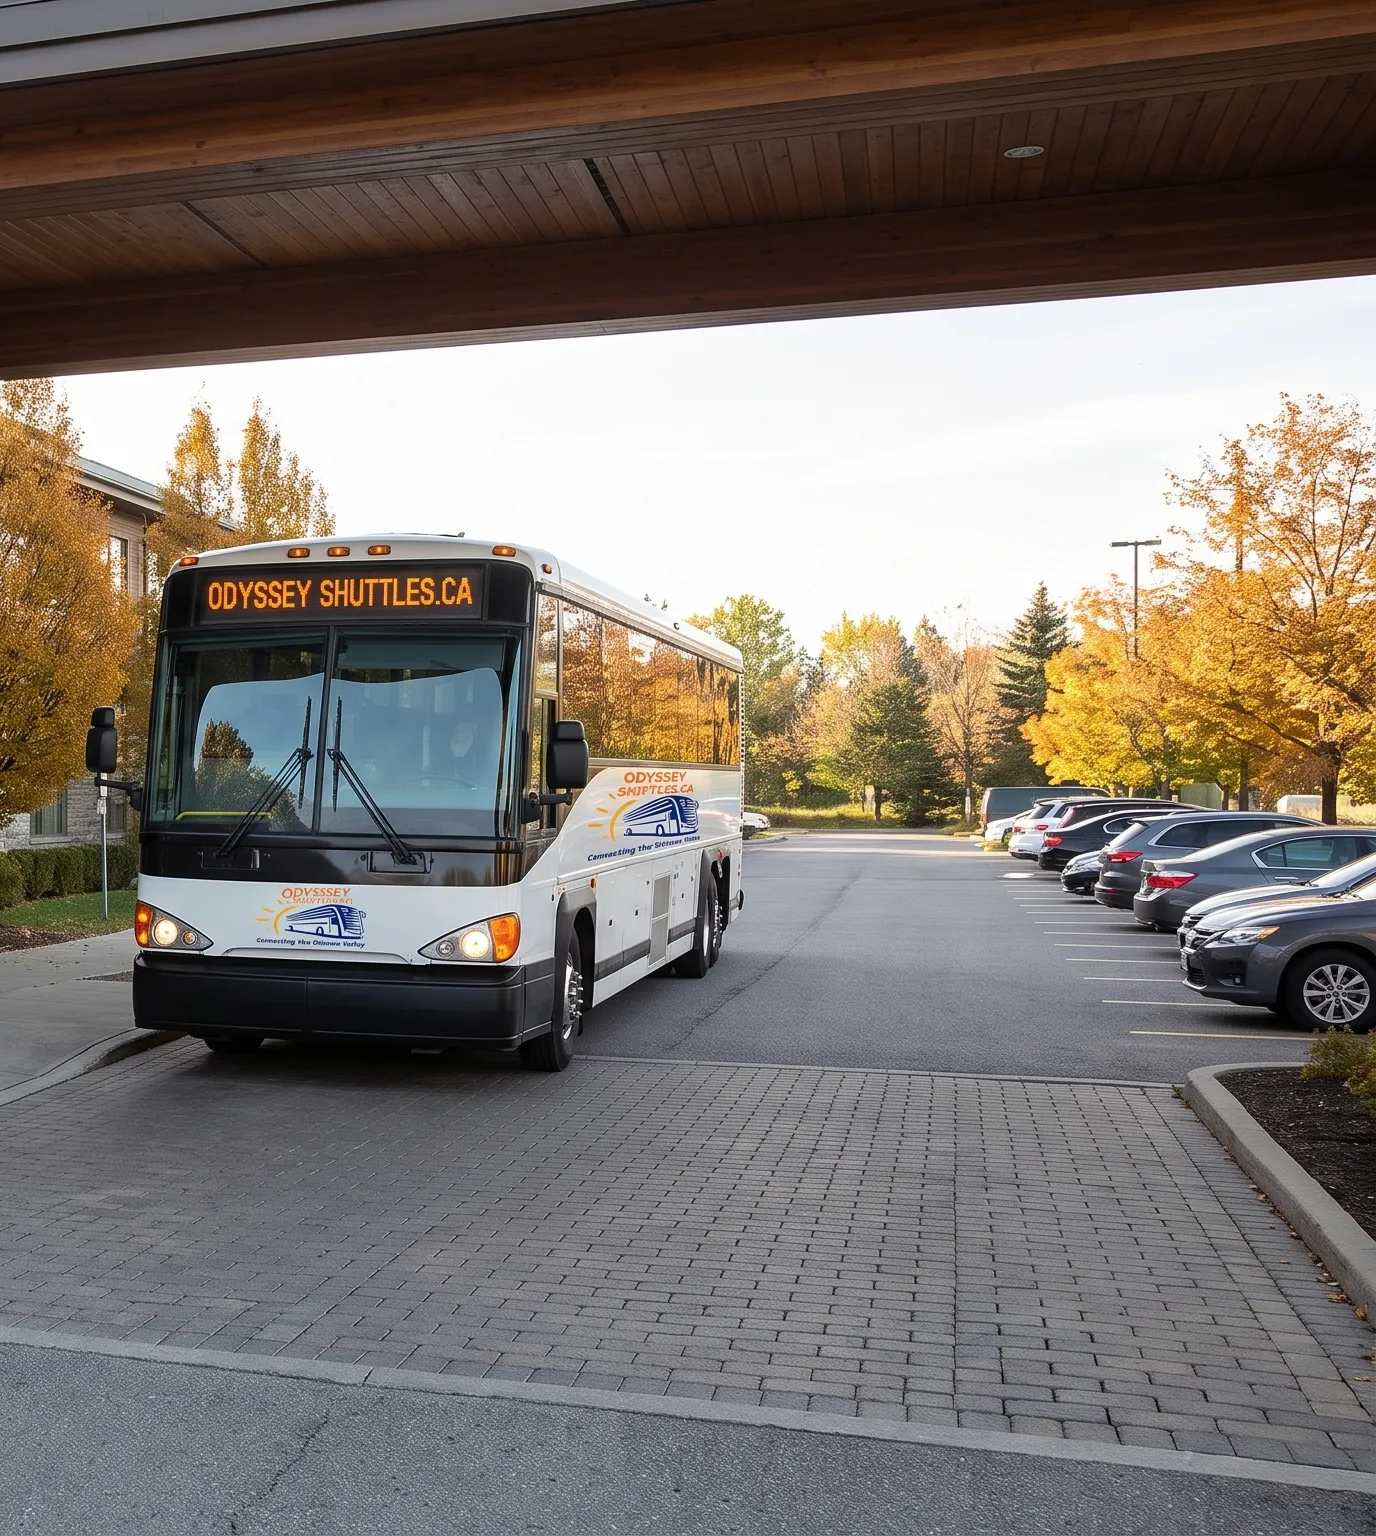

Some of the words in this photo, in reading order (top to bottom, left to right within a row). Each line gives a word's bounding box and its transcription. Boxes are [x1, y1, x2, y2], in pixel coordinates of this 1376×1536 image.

[208, 579, 312, 610] ODYSSEY
[320, 577, 473, 607] SHUTTLES.CA
[624, 771, 687, 783] ODYSSEY
